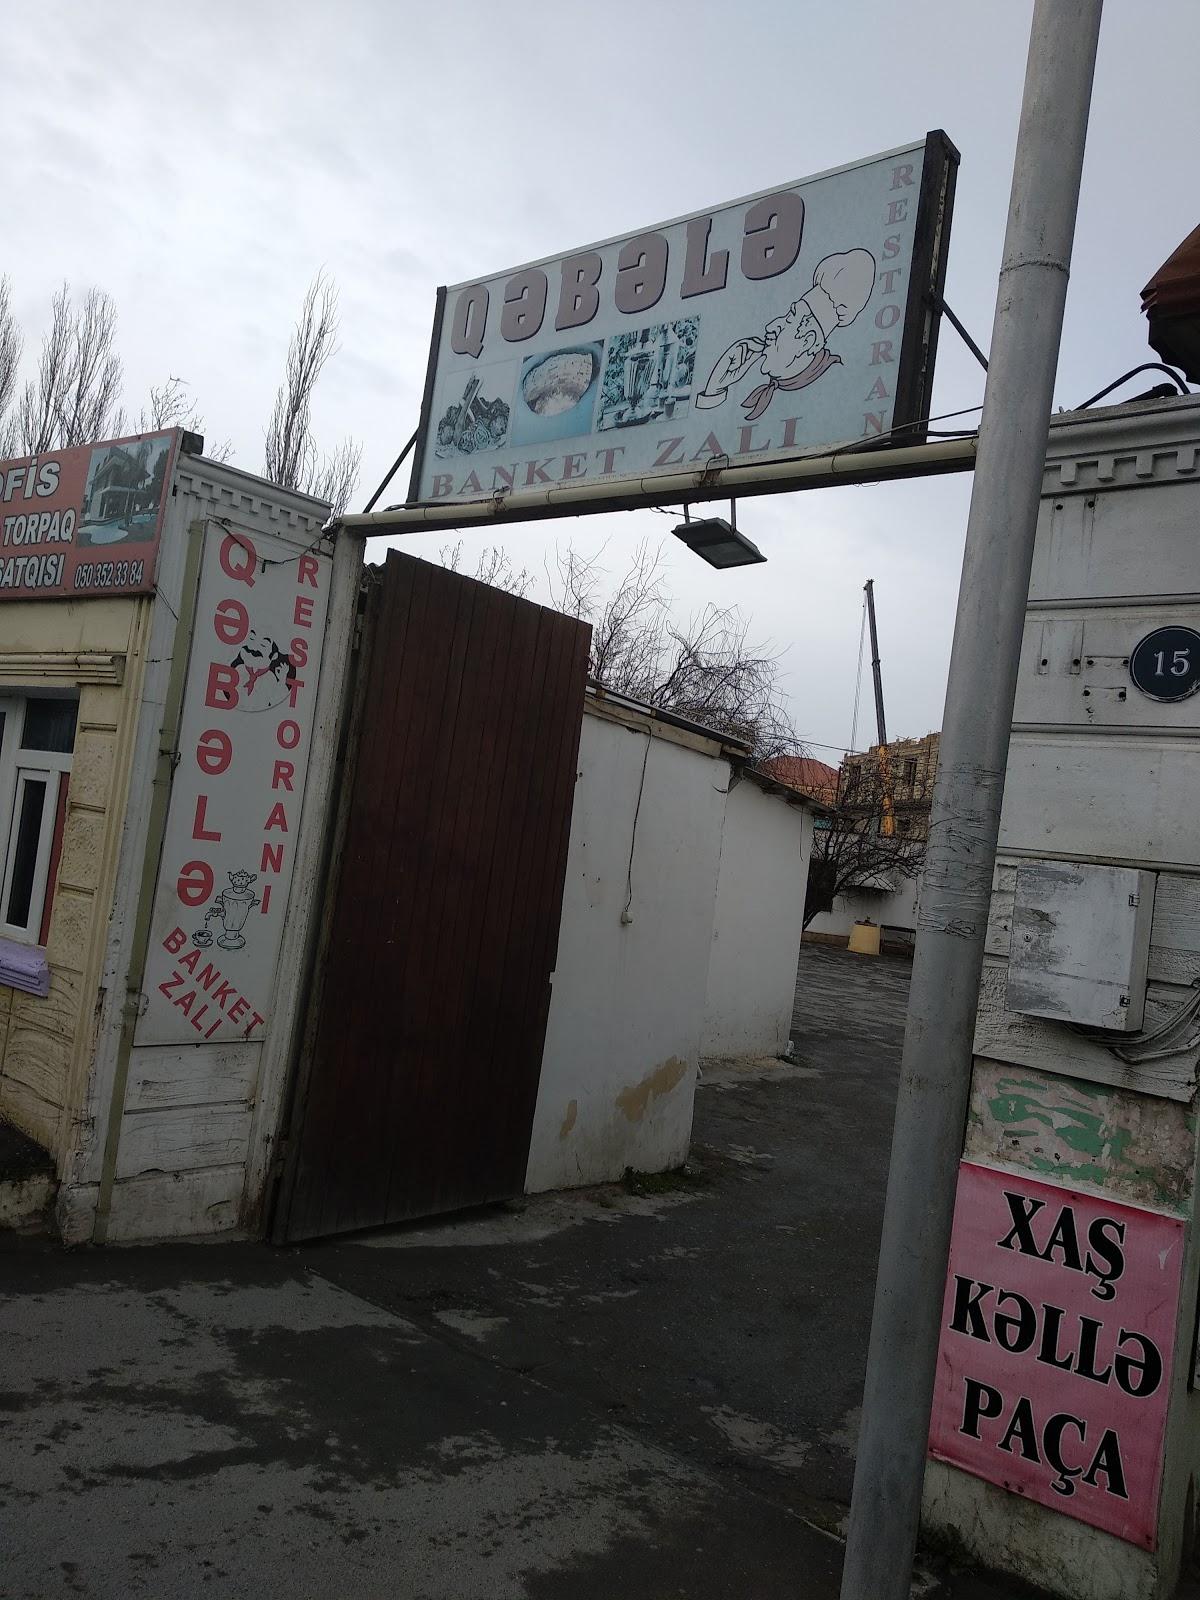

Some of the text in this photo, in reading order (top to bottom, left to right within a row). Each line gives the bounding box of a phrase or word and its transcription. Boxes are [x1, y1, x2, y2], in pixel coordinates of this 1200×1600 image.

[451, 191, 806, 360] QƏBƏLƏ
[860, 163, 915, 437] RESTORAN
[0, 457, 61, 502] FİS
[429, 416, 803, 499] BANKET ZALI
[3, 507, 76, 547] TORPAQ
[74, 559, 144, 589] 050 352 33 84
[1153, 648, 1191, 677] 15
[177, 533, 257, 907] QƏBƏLƏ
[260, 555, 319, 914] RESTORANI
[158, 970, 223, 1039] ZALI
[162, 926, 265, 1037] BANKET
[996, 1190, 1127, 1302] XAŞ
[948, 1272, 1163, 1399] KƏLLƏ
[958, 1375, 1130, 1500] PAÇA
